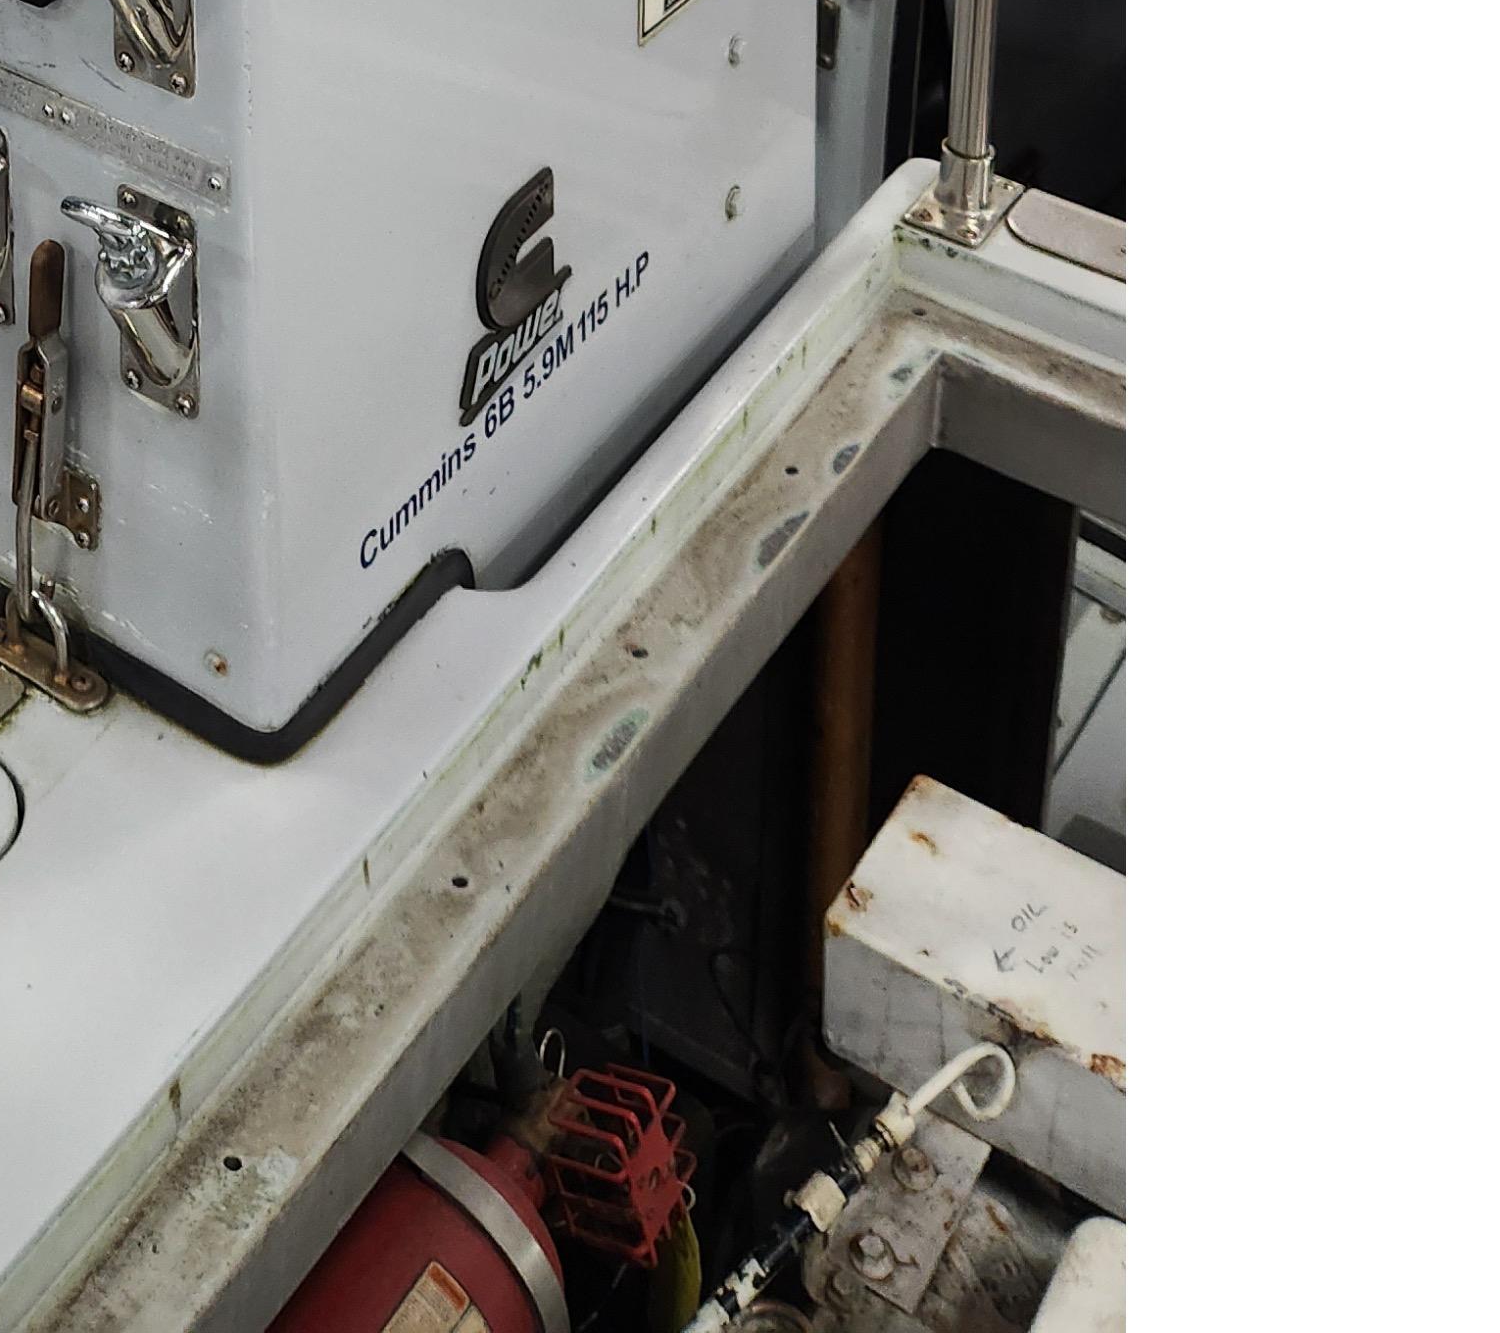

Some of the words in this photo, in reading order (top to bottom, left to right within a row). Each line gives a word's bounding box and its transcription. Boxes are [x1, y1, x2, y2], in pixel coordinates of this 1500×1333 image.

[360, 432, 477, 569] Cummins
[484, 386, 515, 439] 6B
[616, 251, 649, 307] H.P
[1011, 903, 1049, 932] OIL
